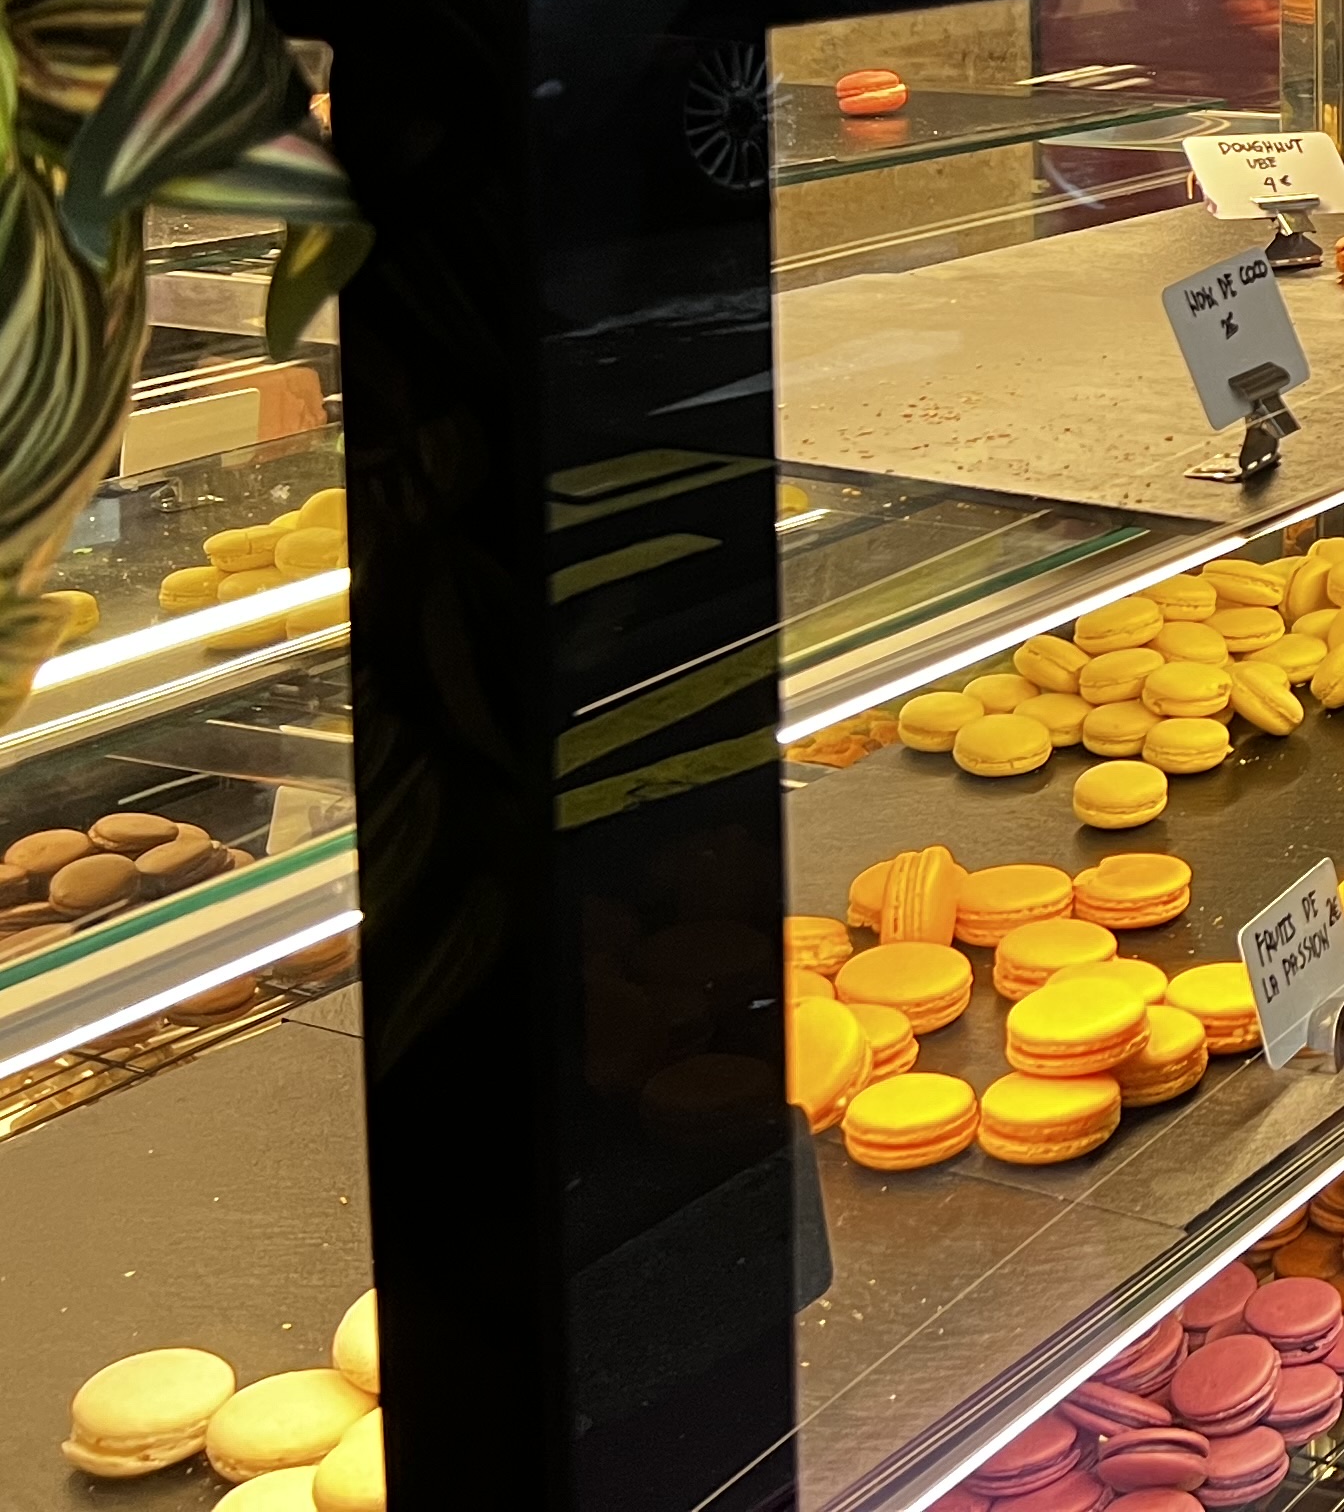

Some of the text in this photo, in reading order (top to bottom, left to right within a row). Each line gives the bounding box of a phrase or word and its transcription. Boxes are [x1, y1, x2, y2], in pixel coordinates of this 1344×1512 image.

[1216, 273, 1238, 300] DE
[1301, 889, 1319, 924] DE
[1261, 922, 1331, 1004] LA PASSION
